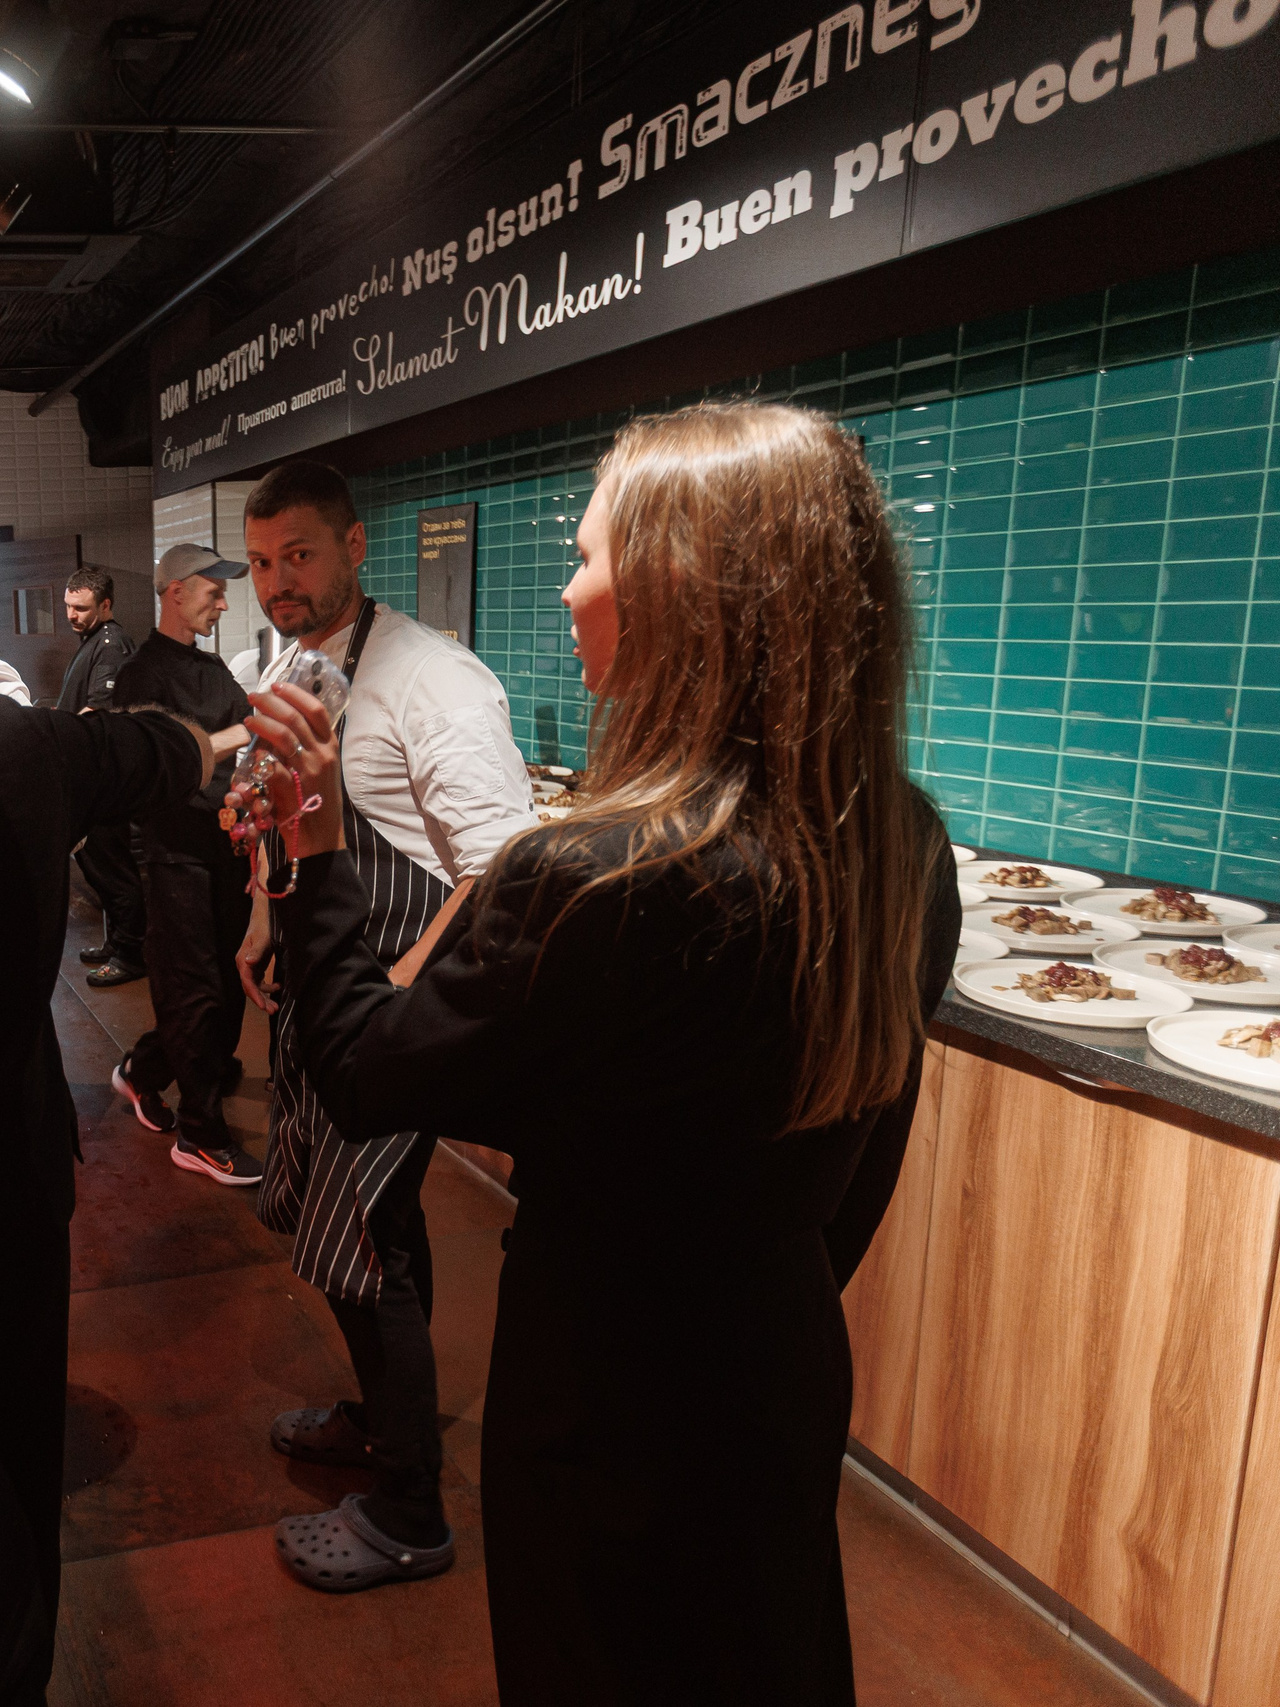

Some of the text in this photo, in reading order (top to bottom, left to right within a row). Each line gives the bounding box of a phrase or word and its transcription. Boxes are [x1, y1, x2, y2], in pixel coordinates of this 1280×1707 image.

[402, 159, 583, 296] Nuş olsun!
[663, 169, 813, 268] Buen
[270, 258, 395, 360] Buen provecho!
[353, 232, 645, 395] Selamat Makan!
[160, 334, 265, 421] BUON APPETITO!
[237, 369, 347, 435] Приятного аппетита!
